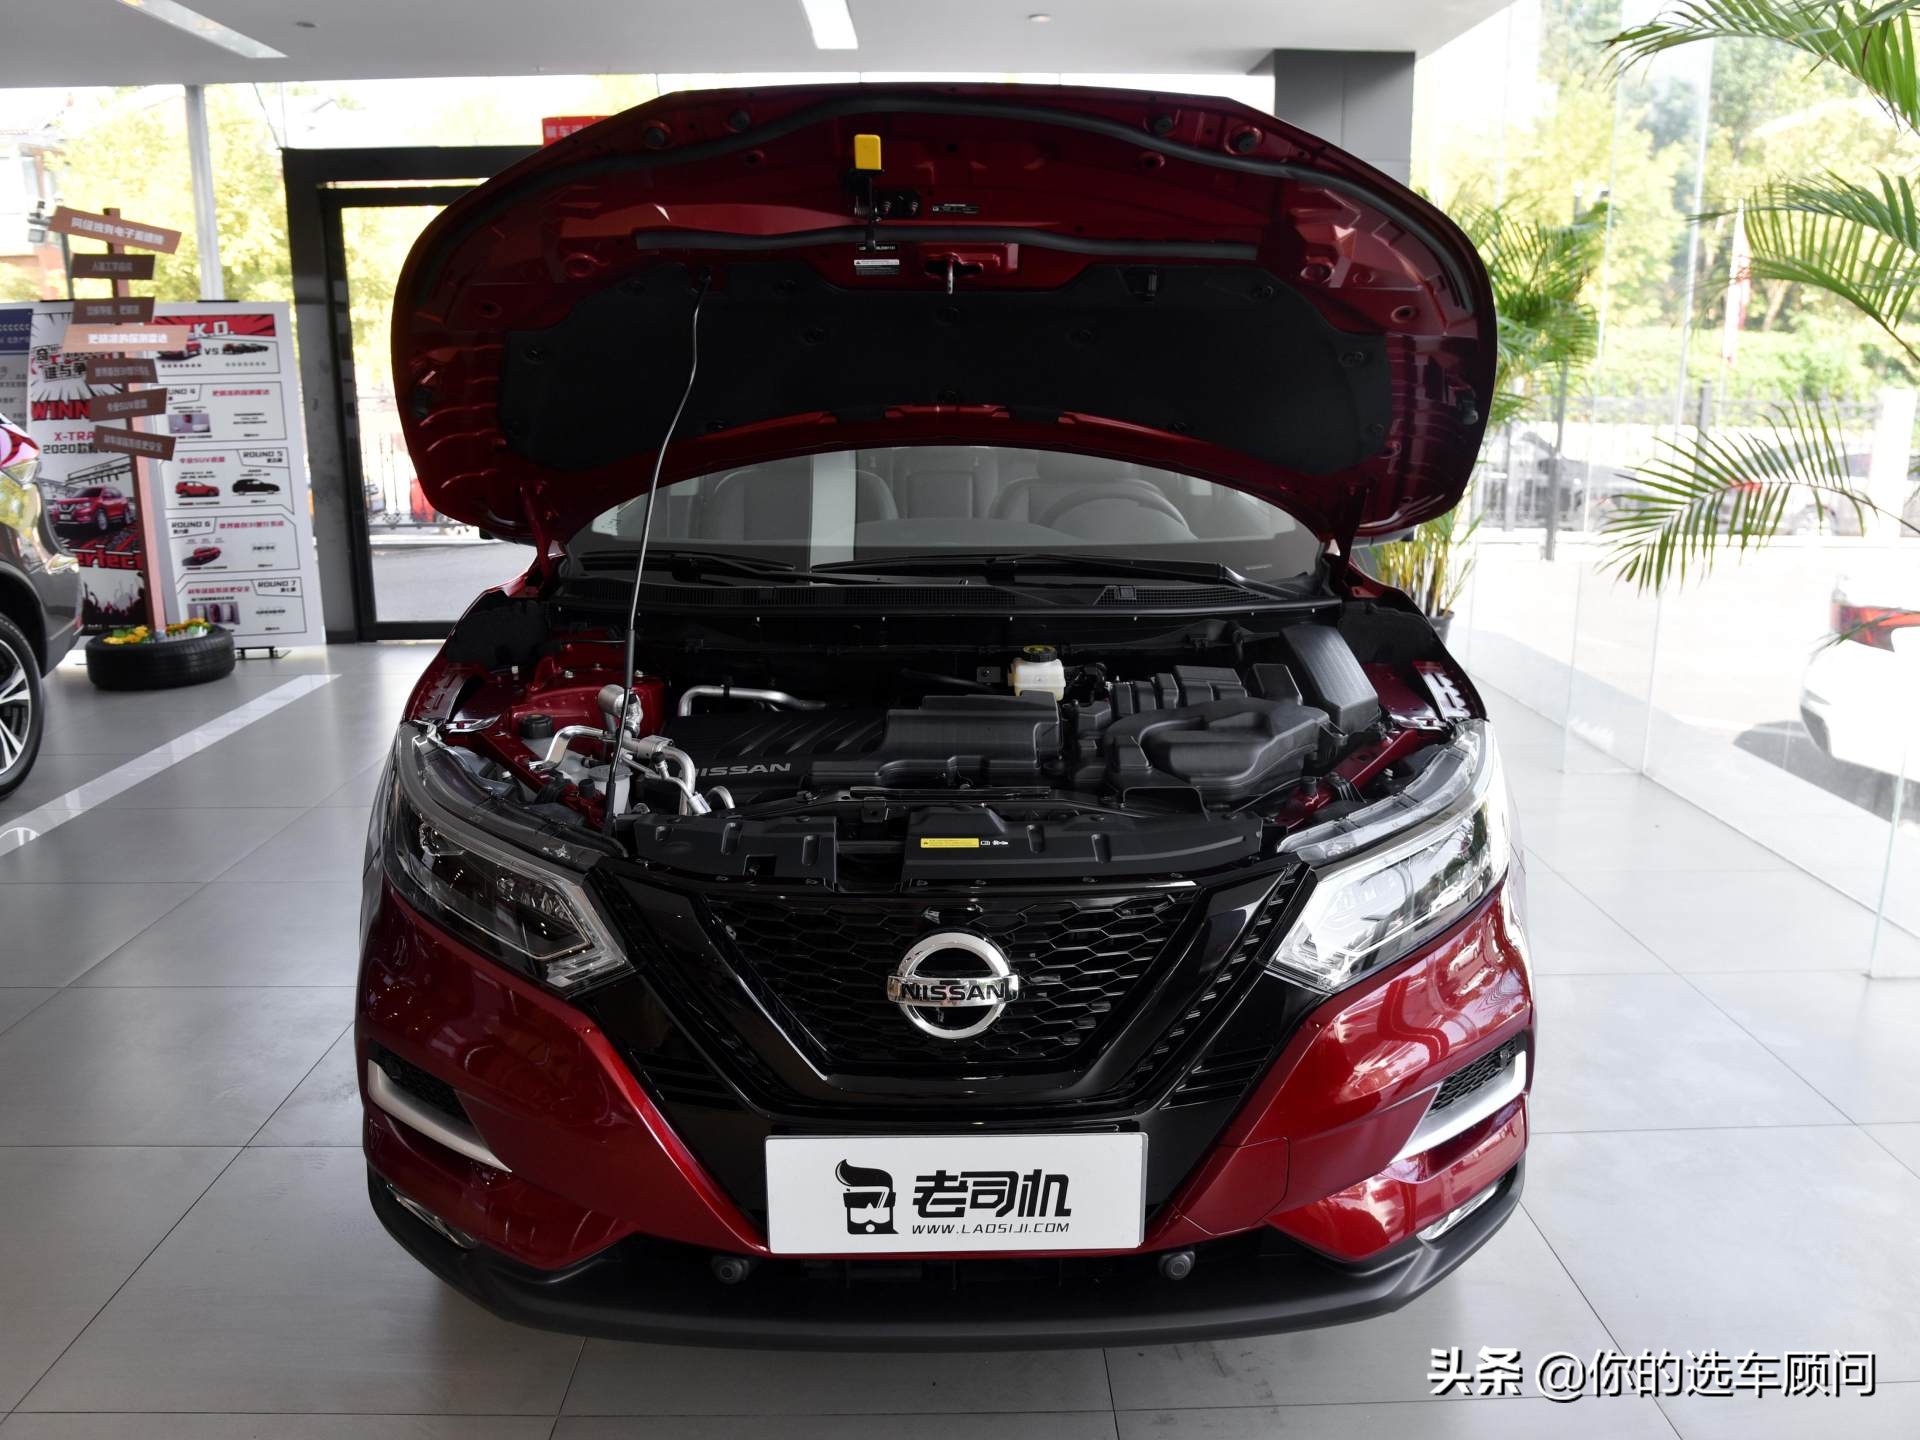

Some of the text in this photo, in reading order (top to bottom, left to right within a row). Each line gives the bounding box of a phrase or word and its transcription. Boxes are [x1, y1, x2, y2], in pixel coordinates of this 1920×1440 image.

[31, 400, 92, 420] WINN
[54, 431, 96, 441] X-TRA
[695, 763, 791, 777] ISSAN
[900, 982, 1010, 1001] NISSAN
[912, 1169, 1072, 1218] 老司机
[912, 1223, 1070, 1234] WWW.LAOSIJI.COM
